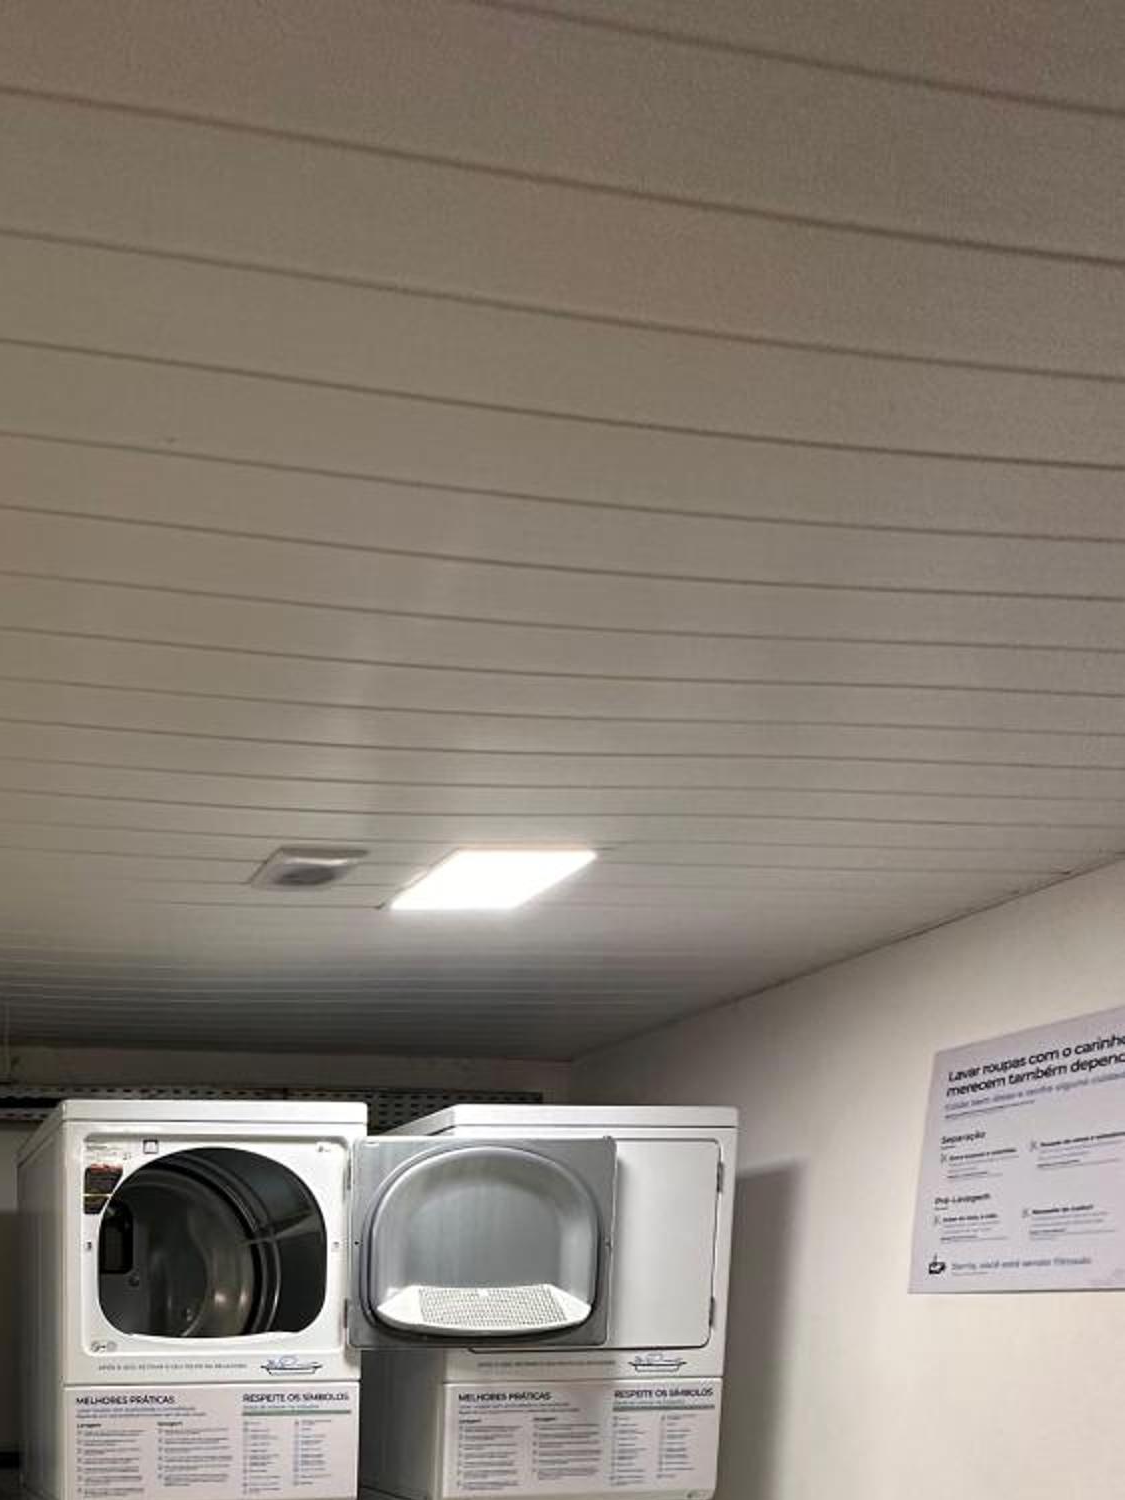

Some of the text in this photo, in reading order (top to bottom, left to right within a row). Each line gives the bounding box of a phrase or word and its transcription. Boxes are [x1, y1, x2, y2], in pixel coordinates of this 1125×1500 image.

[948, 1066, 980, 1083] Lavar
[983, 1057, 1026, 1076] roupas
[1029, 1050, 1059, 1065] com
[1062, 1047, 1072, 1059] o
[946, 1076, 1005, 1098] merecem
[1009, 1063, 1067, 1086] também
[941, 1131, 986, 1145] Separação
[75, 1395, 175, 1405] MELHORES PRÁTICAS
[242, 1394, 285, 1402] RESPEITE
[302, 1391, 349, 1401] SÍMBOLOS
